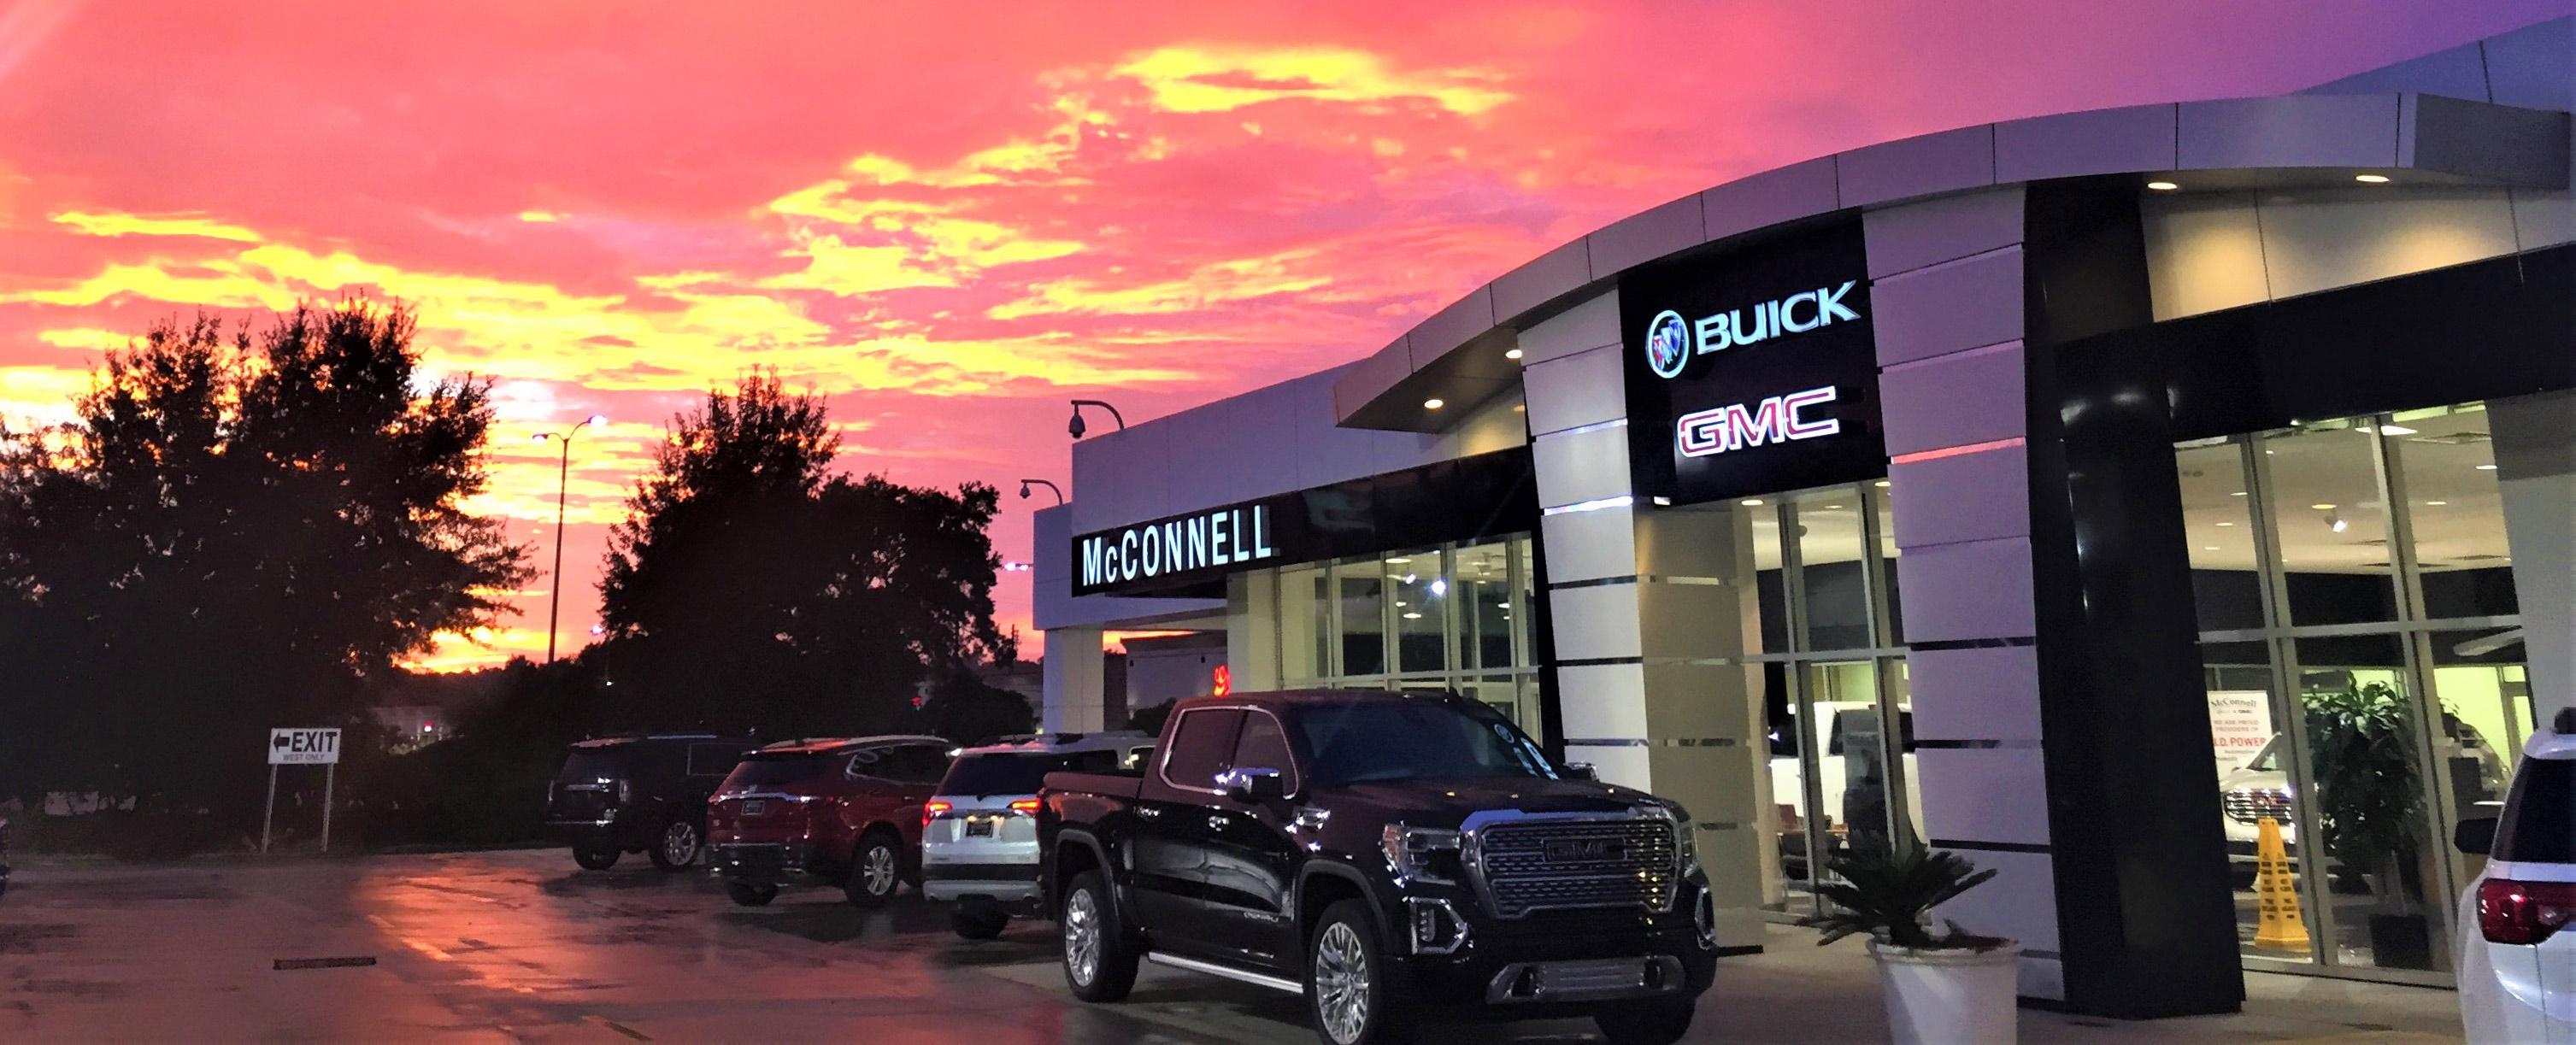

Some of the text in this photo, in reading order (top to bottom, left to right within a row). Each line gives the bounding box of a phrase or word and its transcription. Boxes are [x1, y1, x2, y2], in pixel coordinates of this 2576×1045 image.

[1695, 280, 1861, 355] BUICK
[1678, 385, 1839, 457] GMC
[1083, 505, 1272, 586] McCONNELL
[291, 731, 337, 752] EXIT
